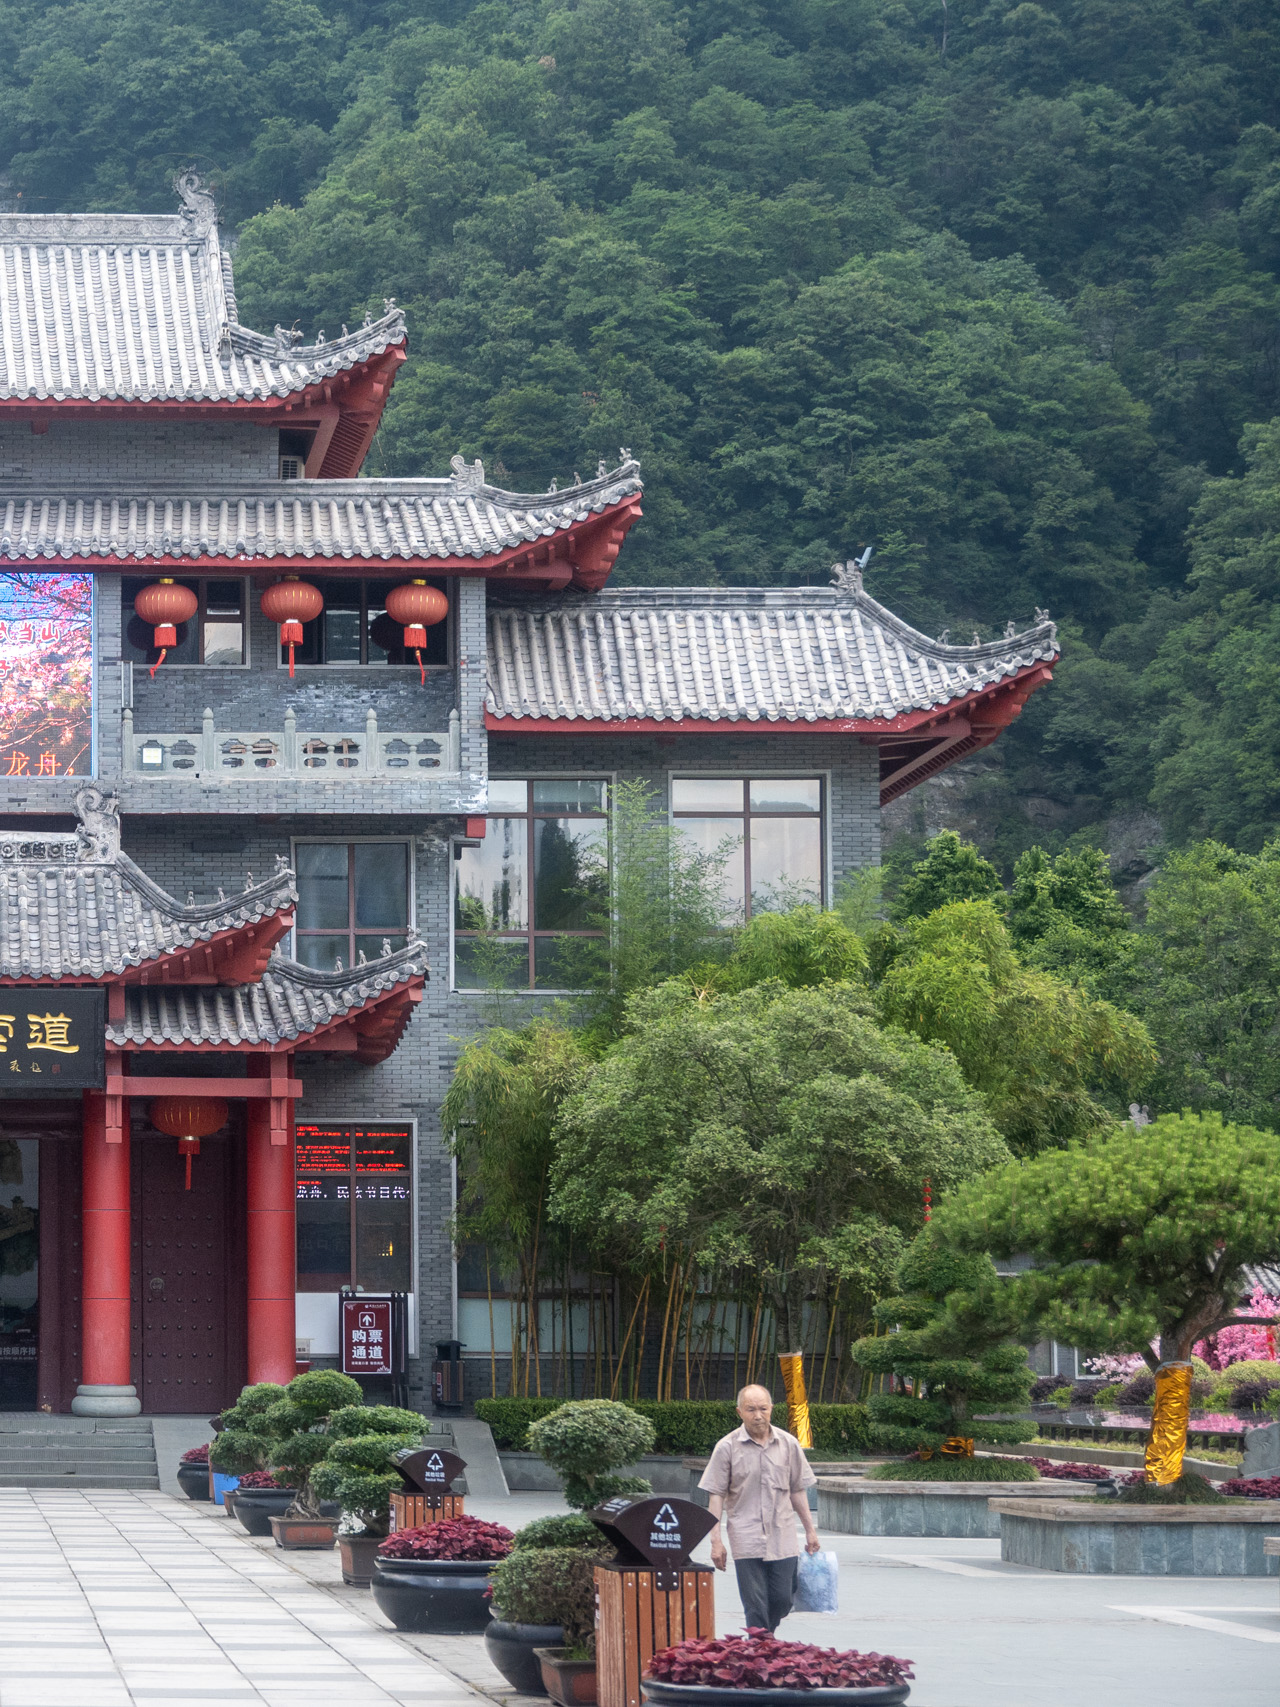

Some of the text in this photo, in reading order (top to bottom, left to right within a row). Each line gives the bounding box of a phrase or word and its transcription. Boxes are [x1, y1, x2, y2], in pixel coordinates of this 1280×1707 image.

[352, 1329, 383, 1343] 购票
[352, 1345, 383, 1359] 通道
[650, 1532, 681, 1542] 其他垃圾
